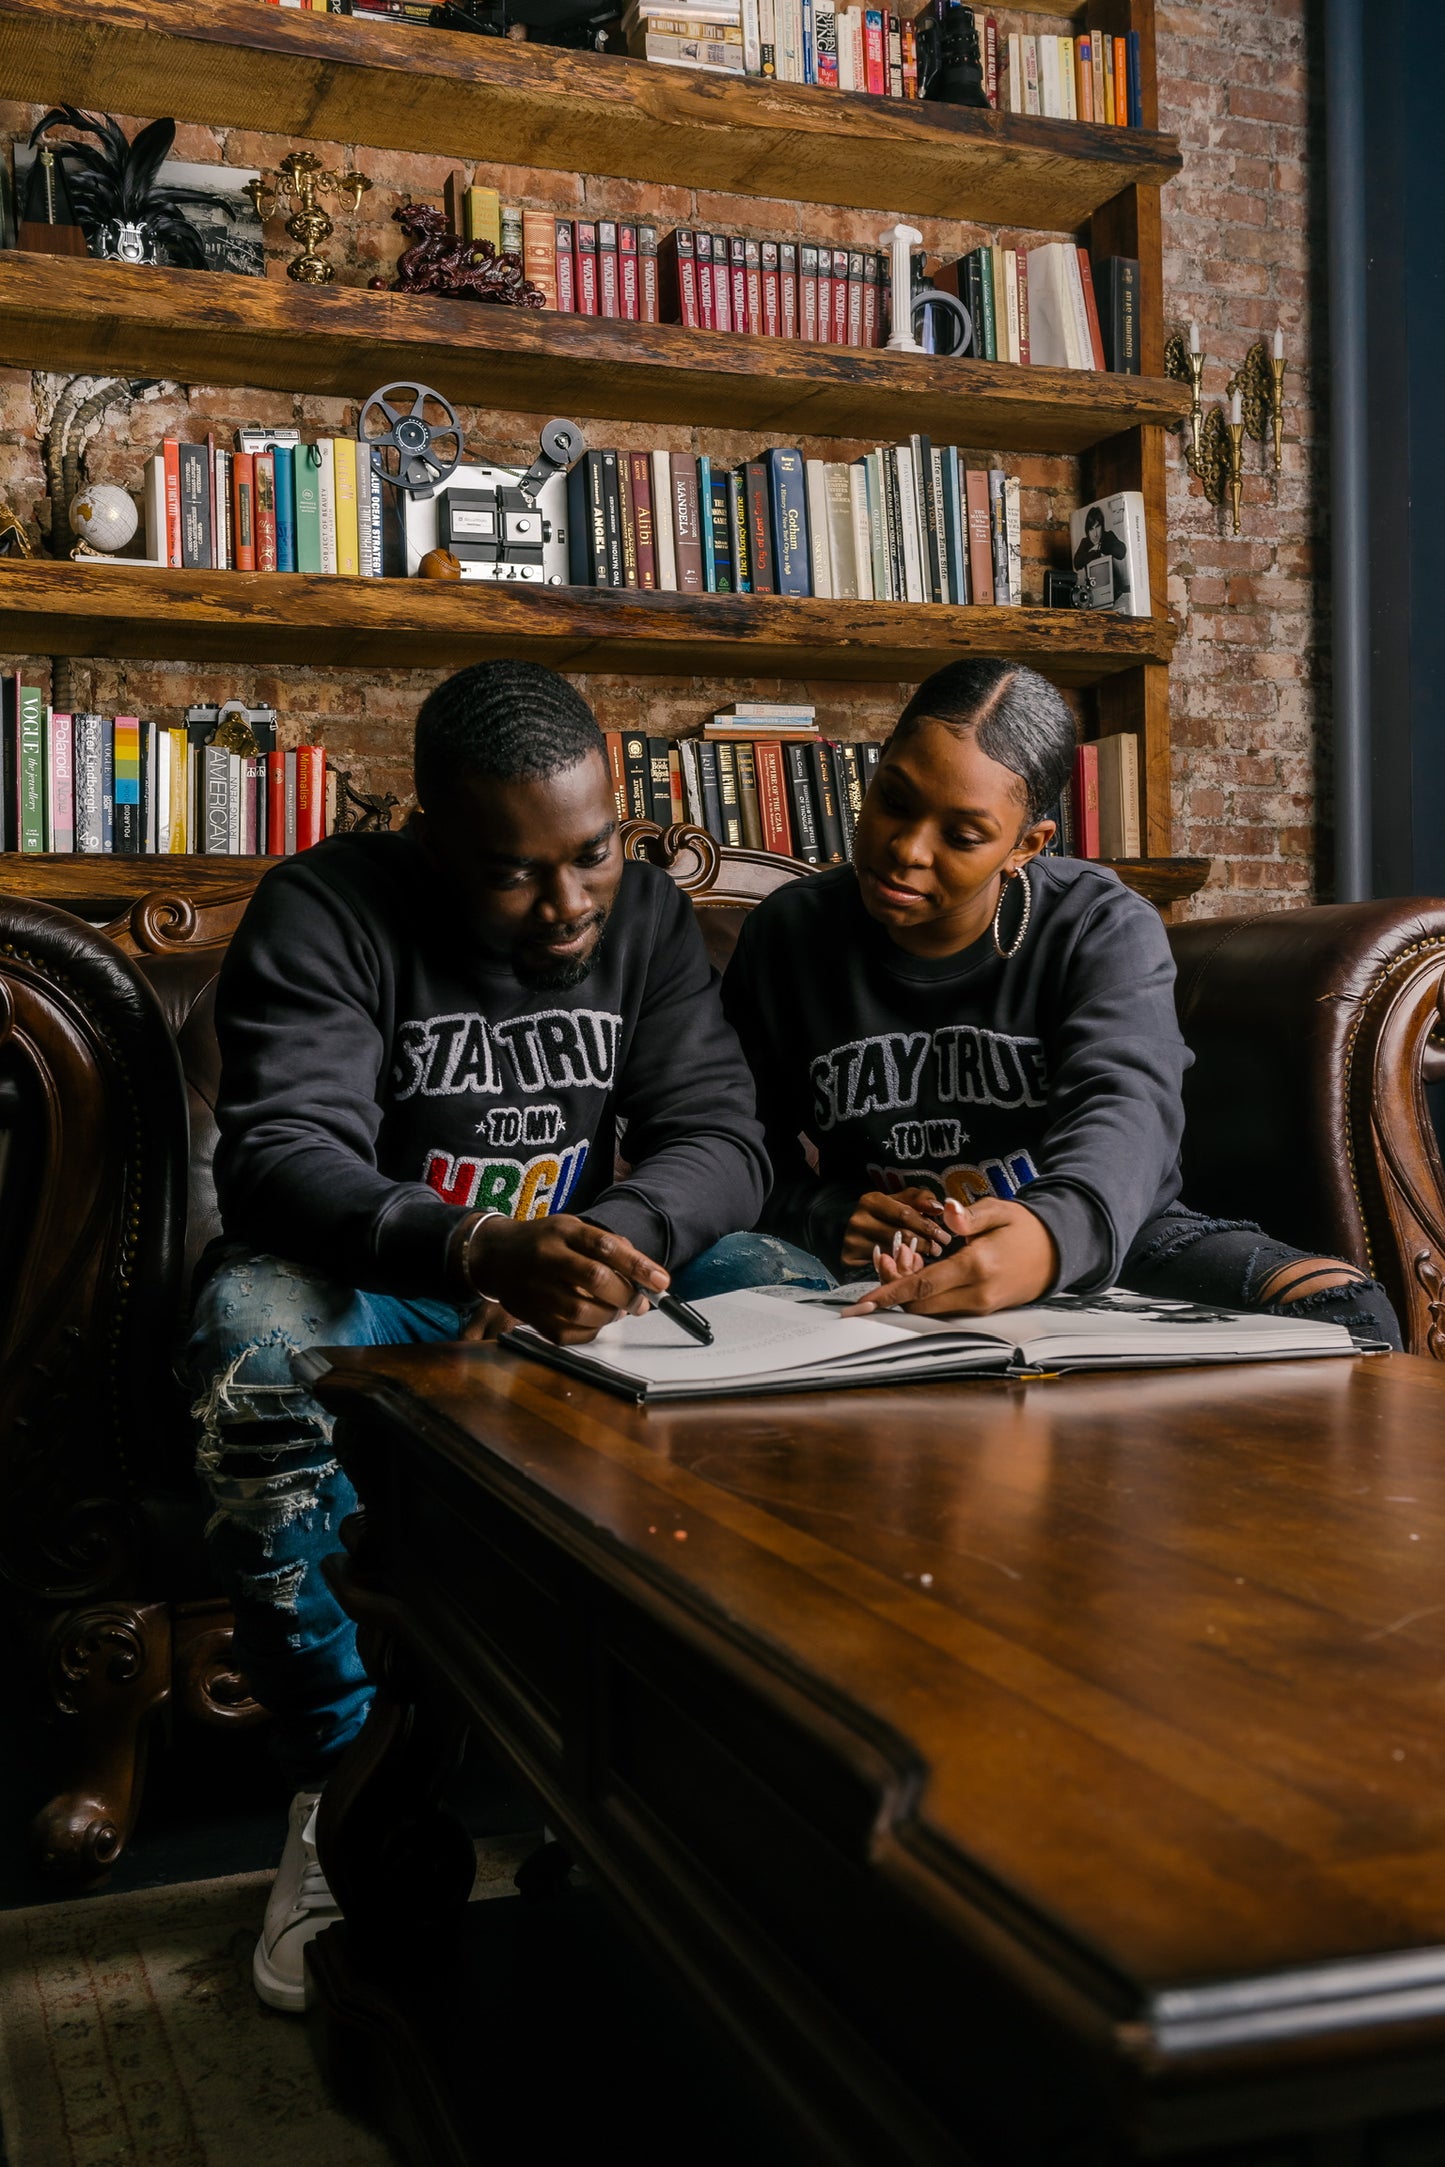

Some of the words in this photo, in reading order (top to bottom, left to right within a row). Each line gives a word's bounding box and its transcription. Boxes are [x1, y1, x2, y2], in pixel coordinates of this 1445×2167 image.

[817, 12, 827, 50] KING
[826, 14, 835, 51] STEPHEN
[560, 257, 571, 298] ПИКУЛЬ
[583, 258, 594, 299] ПИКУЛЬ
[604, 256, 614, 297] ПИКУЛЬ
[624, 260, 634, 300] ПИКУЛЬ
[645, 261, 655, 301] ПИКУЛЬ
[681, 263, 695, 304] ПИКУЛЬ
[698, 267, 712, 307] ПИКУЛЬ
[714, 270, 727, 310] ПИКУЛЬ
[732, 271, 745, 312] ПИКУЛЬ
[747, 274, 759, 314] ПИКУЛЬ
[765, 276, 777, 316] ПИКУЛЬ
[784, 277, 794, 316] ПИКУЛЬ
[803, 281, 815, 320] ПИКУЛЬ
[819, 282, 830, 321] ПИКУЛЬ
[836, 284, 846, 323] ПИКУЛЬ
[851, 286, 861, 324] ПИКУЛЬ
[865, 289, 875, 327] ПИКУЛЬ
[1123, 290, 1132, 313] ATLAS
[933, 455, 941, 475] Life
[917, 473, 925, 499] NEW
[935, 477, 941, 487] on
[359, 504, 371, 522] DIET
[371, 495, 381, 527] OCEAN
[676, 480, 689, 536] MANDELA
[713, 499, 726, 508] THE
[736, 496, 745, 525] Game
[754, 491, 763, 515] Souls
[872, 509, 880, 527] OLD
[905, 494, 913, 526] MODERN
[322, 519, 328, 529] OF
[593, 507, 606, 554] ANGEL
[637, 506, 653, 546] Alibi
[713, 517, 727, 525] GAME
[755, 517, 765, 536] Lost
[788, 509, 799, 550] Gotham
[359, 523, 373, 577] BULLETPROOF
[372, 528, 382, 574] STRATEGY
[737, 527, 747, 558] Money
[757, 539, 764, 548] of
[812, 532, 824, 564] MONEY
[873, 528, 882, 550] CUBA
[739, 560, 748, 576] The
[757, 551, 767, 569] City
[814, 566, 824, 583] OLD
[940, 560, 948, 580] Side
[21, 698, 39, 754] VOGUE
[85, 720, 97, 752] Peter
[27, 757, 38, 771] the
[56, 720, 70, 778] Polaroid
[104, 743, 112, 772] VOGUE
[651, 761, 668, 769] Book
[719, 745, 733, 772] ALASTAIR
[819, 751, 827, 762] LEE
[85, 755, 97, 813] Lindbergh
[104, 773, 112, 786] ON
[300, 753, 309, 810] Minimalism
[768, 753, 777, 784] EMPIRE
[820, 763, 829, 782] CHILD
[1128, 767, 1133, 777] AN
[24, 771, 38, 813] jewellery
[57, 781, 67, 814] Now
[210, 750, 227, 852] AMERICAN
[722, 774, 736, 805] REYNOLDS
[771, 785, 778, 795] OF
[799, 796, 804, 804] OF
[802, 784, 810, 809] BUSINESS
[824, 793, 833, 817] Personal
[774, 813, 782, 833] CZAR
[800, 805, 808, 833] THOUGHT
[492, 1009, 623, 1093] TRU
[809, 1032, 931, 1131] STAY
[934, 1025, 1048, 1108] TRUE
[487, 1107, 522, 1147] TO
[523, 1105, 561, 1145] MY
[891, 1121, 925, 1159] TO
[925, 1119, 961, 1157] MY
[422, 1139, 590, 1221] HBCU
